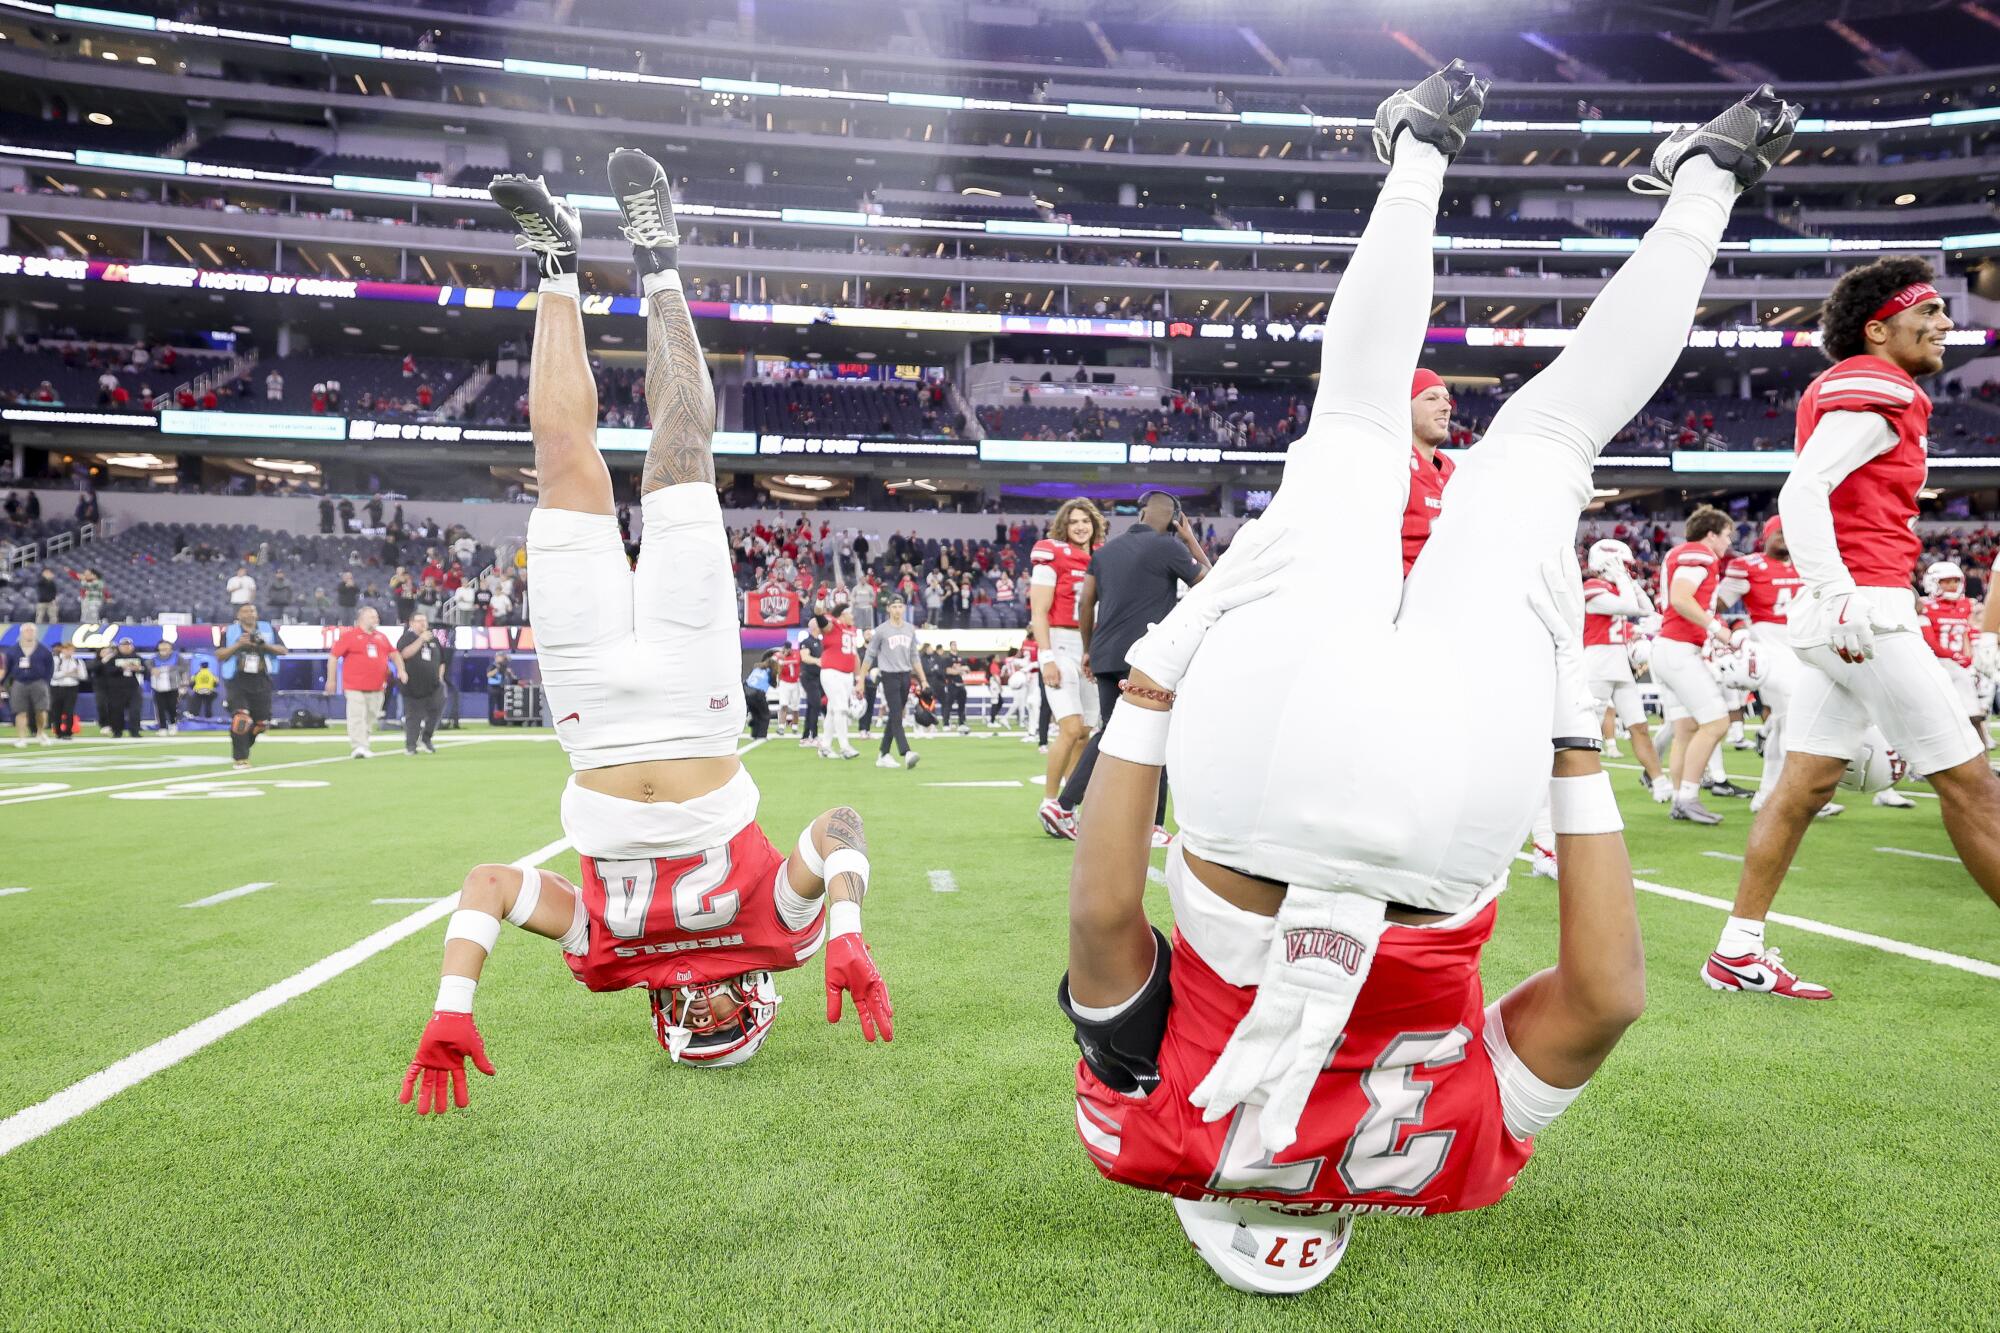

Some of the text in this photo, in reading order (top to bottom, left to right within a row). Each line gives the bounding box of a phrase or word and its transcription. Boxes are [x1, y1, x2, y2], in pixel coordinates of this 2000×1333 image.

[199, 271, 269, 292] HOSTED
[270, 276, 297, 295] BY
[760, 596, 790, 612] UNLV
[72, 624, 119, 648] Cal
[593, 842, 740, 939] 24
[614, 934, 744, 957] REBELS
[1285, 928, 1366, 975] UNLV
[676, 970, 692, 981] UNLV
[1206, 1024, 1473, 1196] 37
[1265, 1237, 1322, 1268] 37
